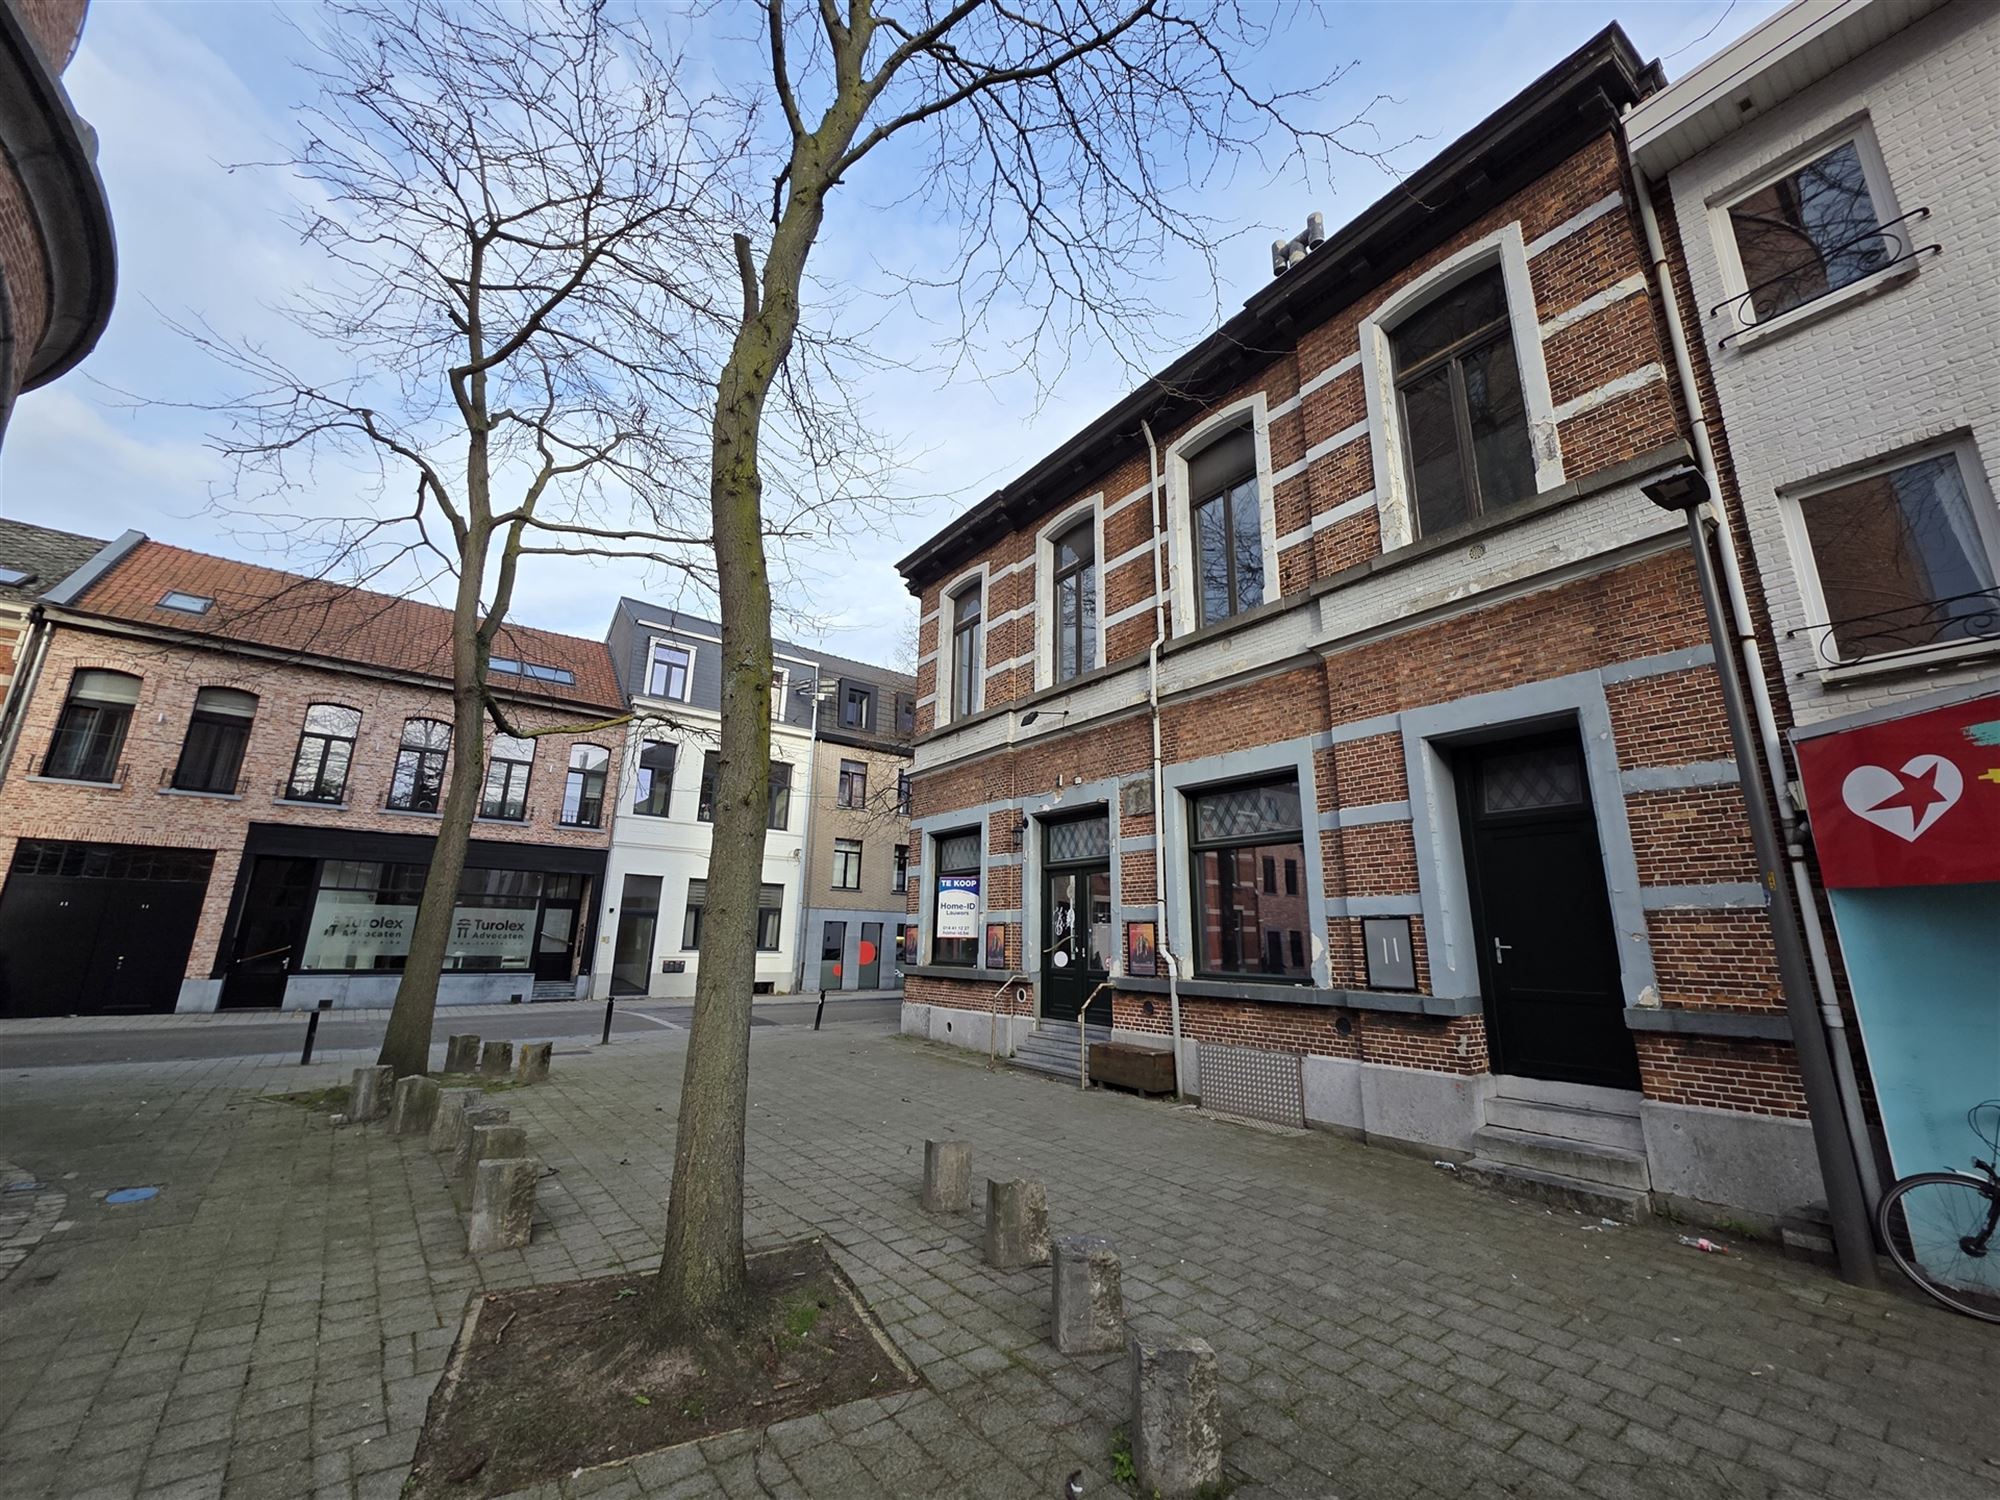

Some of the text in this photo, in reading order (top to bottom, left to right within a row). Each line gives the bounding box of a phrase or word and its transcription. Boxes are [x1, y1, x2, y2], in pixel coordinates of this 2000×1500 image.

[941, 879, 977, 887] TE KOOP
[940, 902, 976, 910] Home-ID
[474, 919, 525, 931] Turolex
[342, 929, 402, 938] Adocaten
[472, 931, 524, 940] Advocaten
